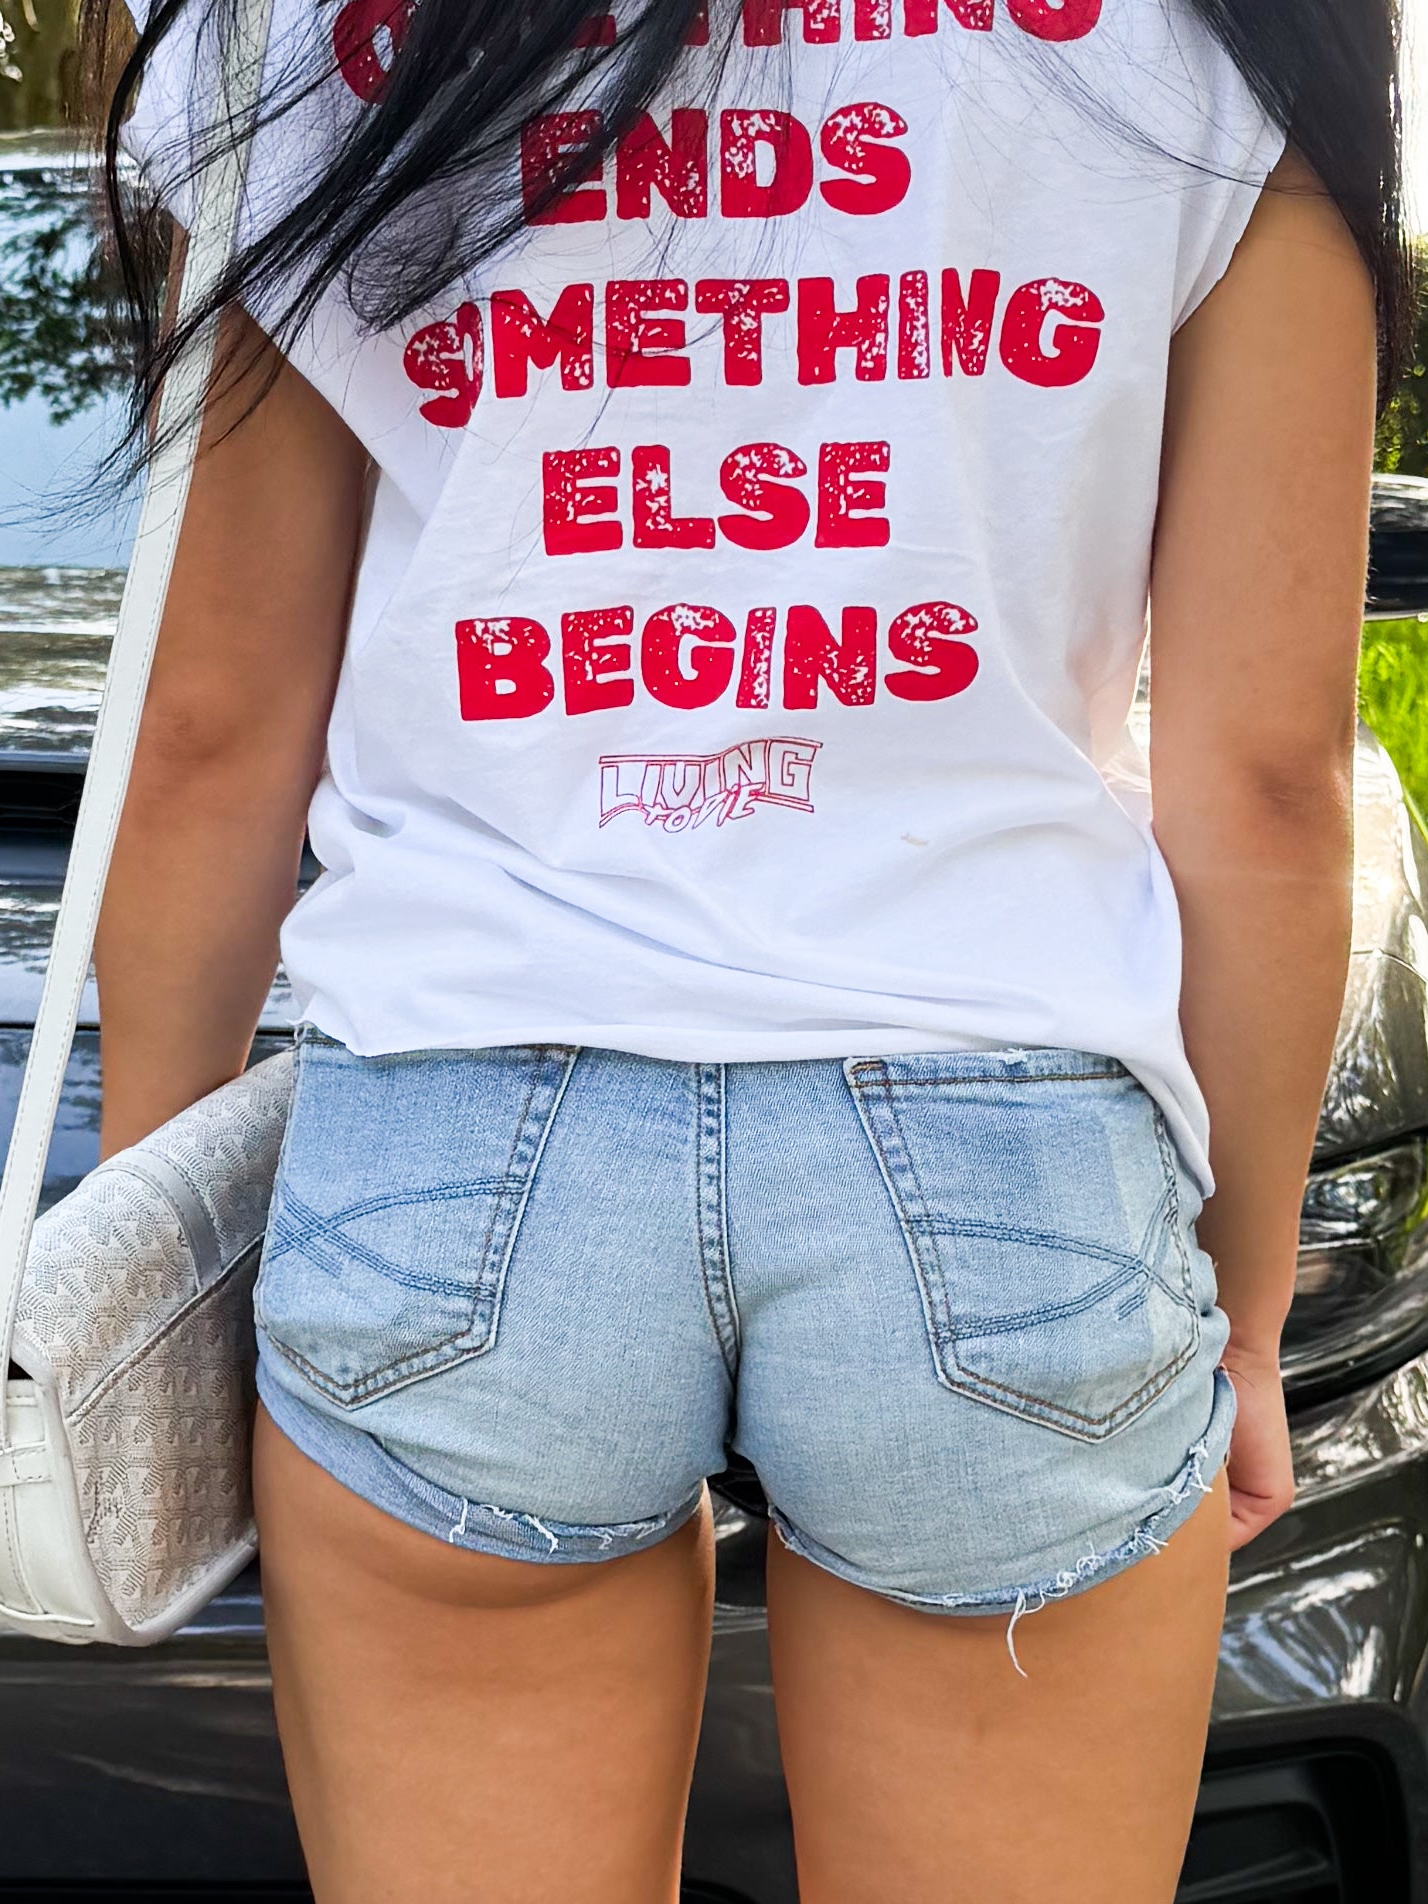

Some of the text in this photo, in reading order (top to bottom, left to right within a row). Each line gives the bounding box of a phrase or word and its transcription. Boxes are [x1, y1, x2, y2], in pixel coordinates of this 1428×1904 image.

[519, 101, 912, 227] ENDS
[541, 440, 891, 558] ELSE
[453, 600, 980, 723] BEGINS
[600, 738, 818, 817] LIVING
